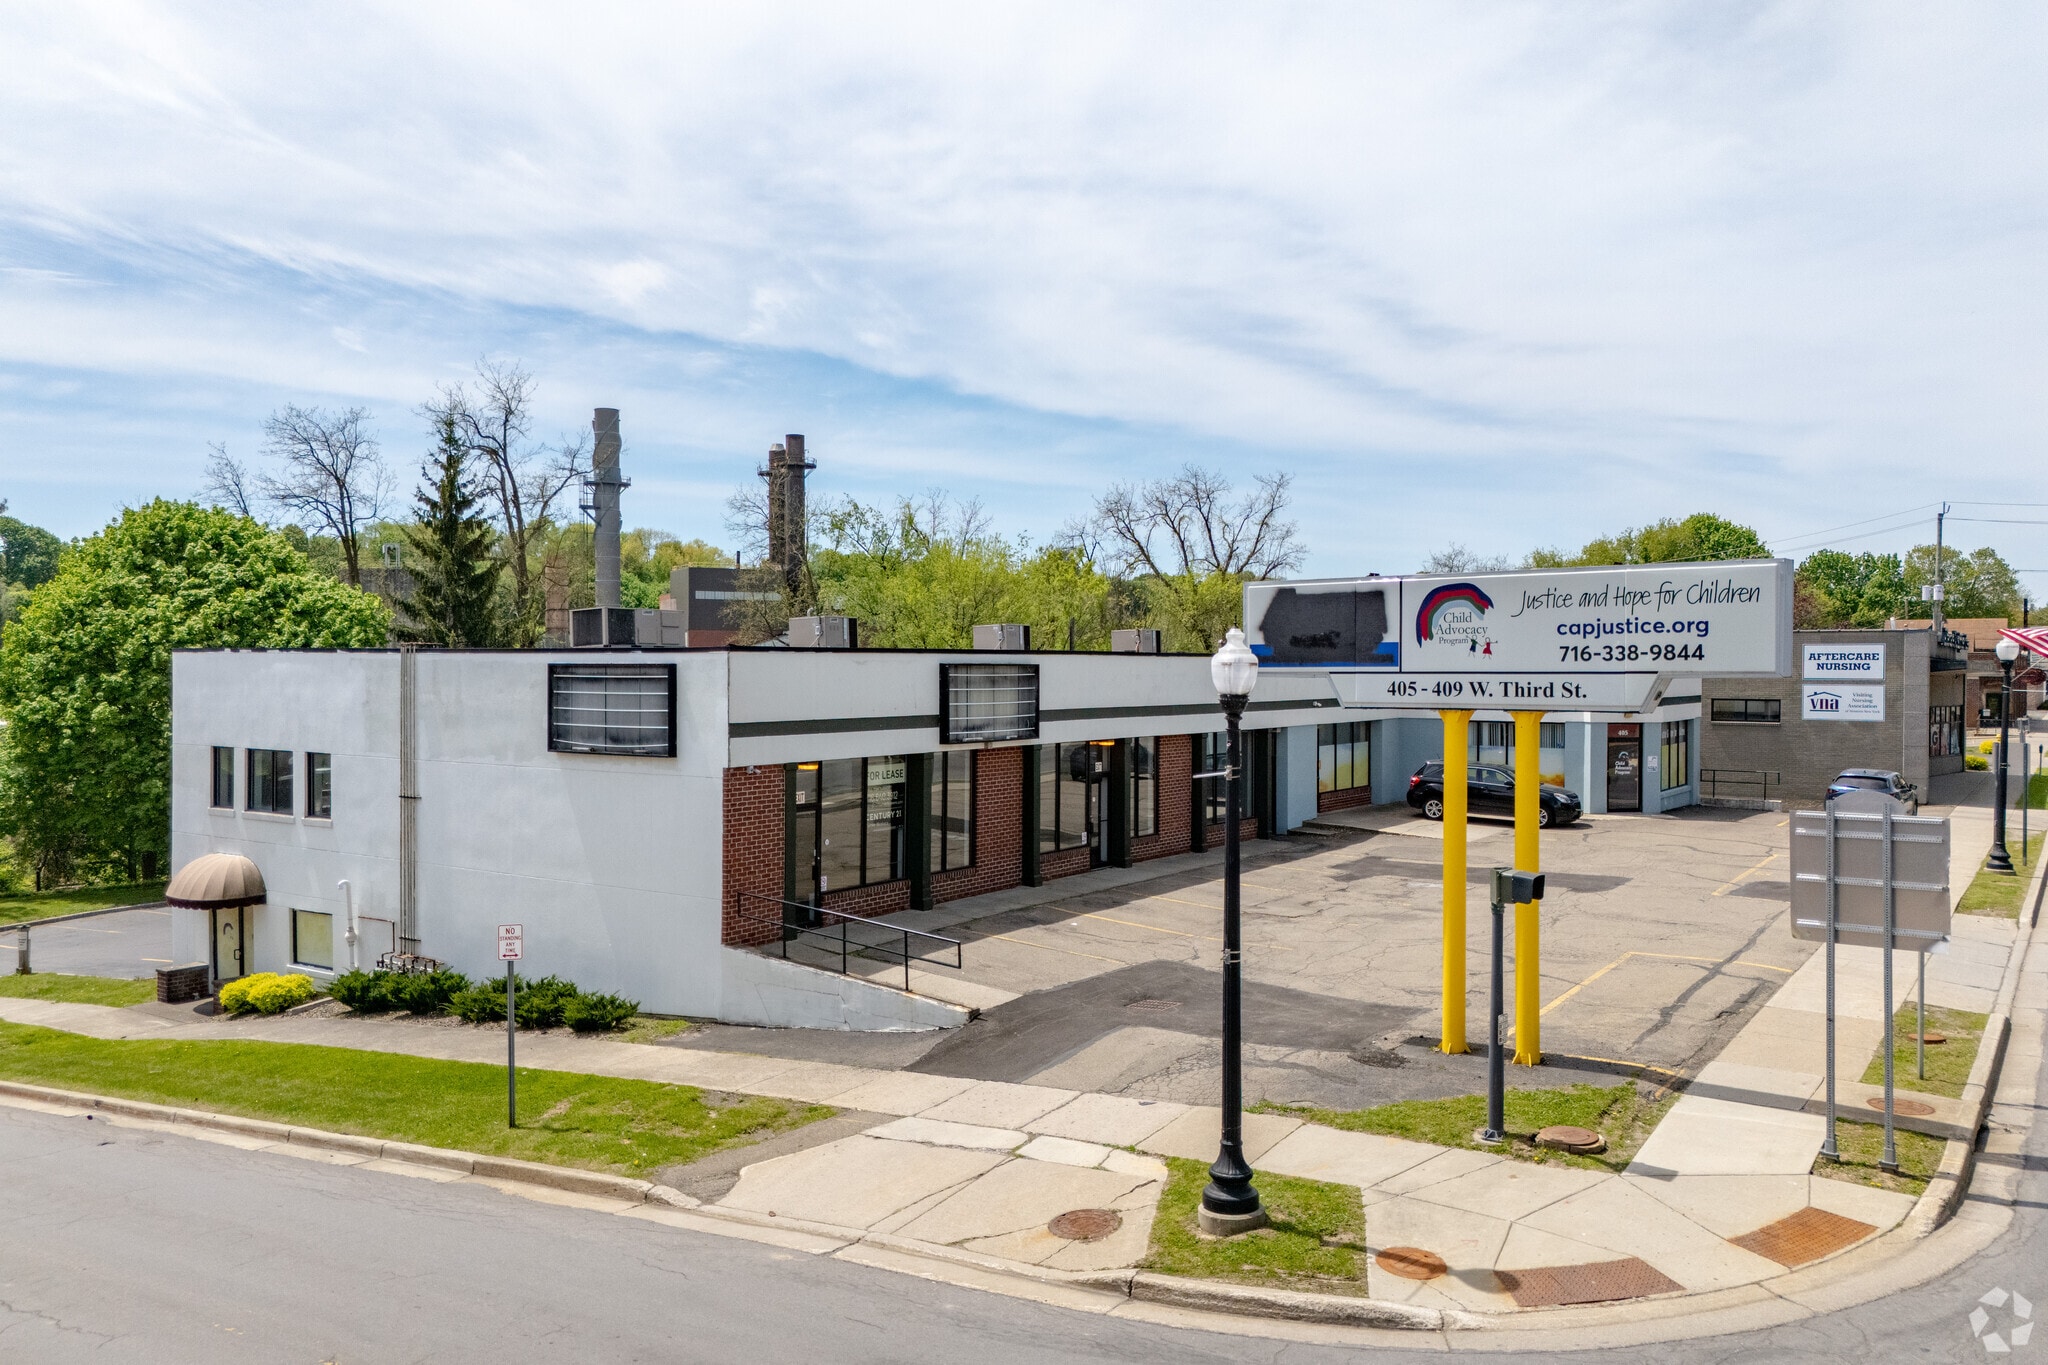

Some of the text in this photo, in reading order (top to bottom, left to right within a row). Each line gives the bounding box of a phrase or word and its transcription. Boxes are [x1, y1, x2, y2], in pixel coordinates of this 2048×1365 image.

[1510, 579, 1760, 617] Justice and Hope for Children
[1443, 611, 1472, 623] Child
[1435, 623, 1488, 638] Advocacy
[1556, 616, 1709, 639] capjustice.org
[1438, 636, 1469, 646] Program
[1559, 643, 1705, 662] 716-338-9844
[1808, 652, 1880, 661] AFTERCARE
[1816, 662, 1871, 671] NURSING
[1468, 681, 1494, 698] W.
[1498, 681, 1555, 698] Third
[1561, 682, 1587, 699] St.
[881, 768, 904, 780] LEASE
[505, 927, 515, 935] NO
